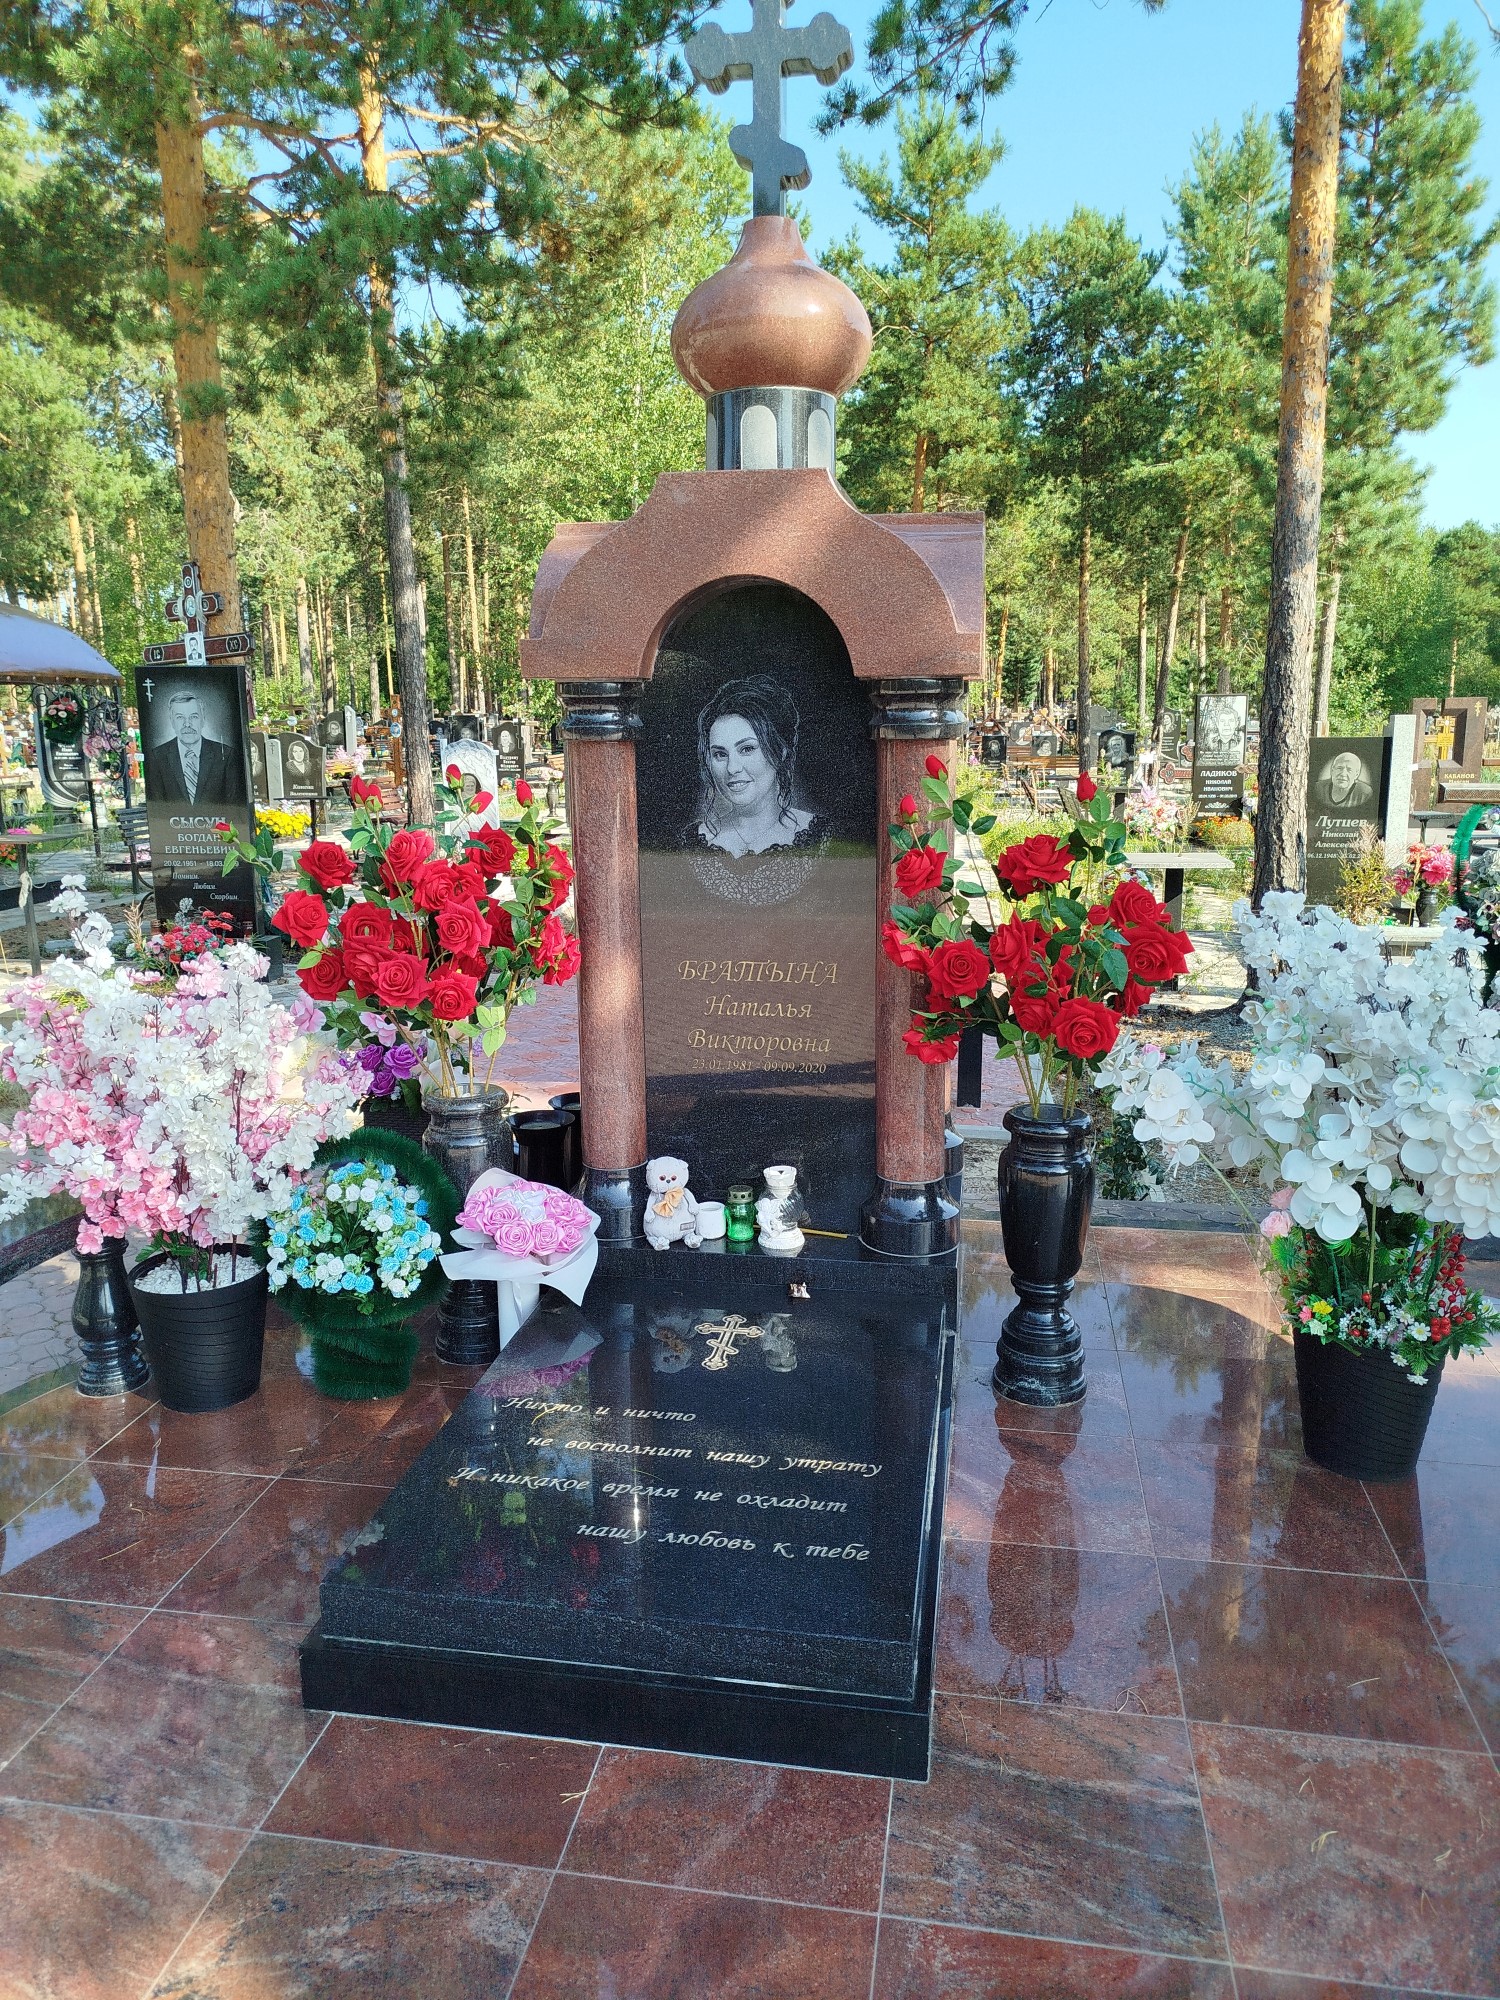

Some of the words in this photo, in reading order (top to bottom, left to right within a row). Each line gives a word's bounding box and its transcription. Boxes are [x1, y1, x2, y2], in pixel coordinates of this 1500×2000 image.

[1315, 815, 1368, 829] Лутцев
[1321, 830, 1360, 838] Николай
[177, 833, 222, 843] БОГДАН
[677, 960, 839, 986] БРАТЫНА
[704, 994, 814, 1018] Наталья
[687, 1028, 832, 1057] Викторовна
[692, 1058, 752, 1071] 23.01.1981
[763, 1061, 827, 1074] 09.09.2020
[502, 1398, 583, 1414] Никто
[595, 1406, 611, 1415] и
[622, 1407, 697, 1422] ничто
[526, 1437, 554, 1447] не
[564, 1439, 693, 1459] восполнит
[706, 1451, 771, 1468] нашу
[778, 1457, 883, 1477] утрату
[452, 1467, 487, 1480] И
[489, 1472, 591, 1492] никакое
[601, 1482, 681, 1498] время
[693, 1490, 723, 1502] не
[736, 1494, 848, 1513] охладит
[576, 1524, 648, 1545] нашу
[657, 1530, 757, 1551] любовь
[772, 1542, 795, 1558] к
[805, 1543, 871, 1561] тебе
